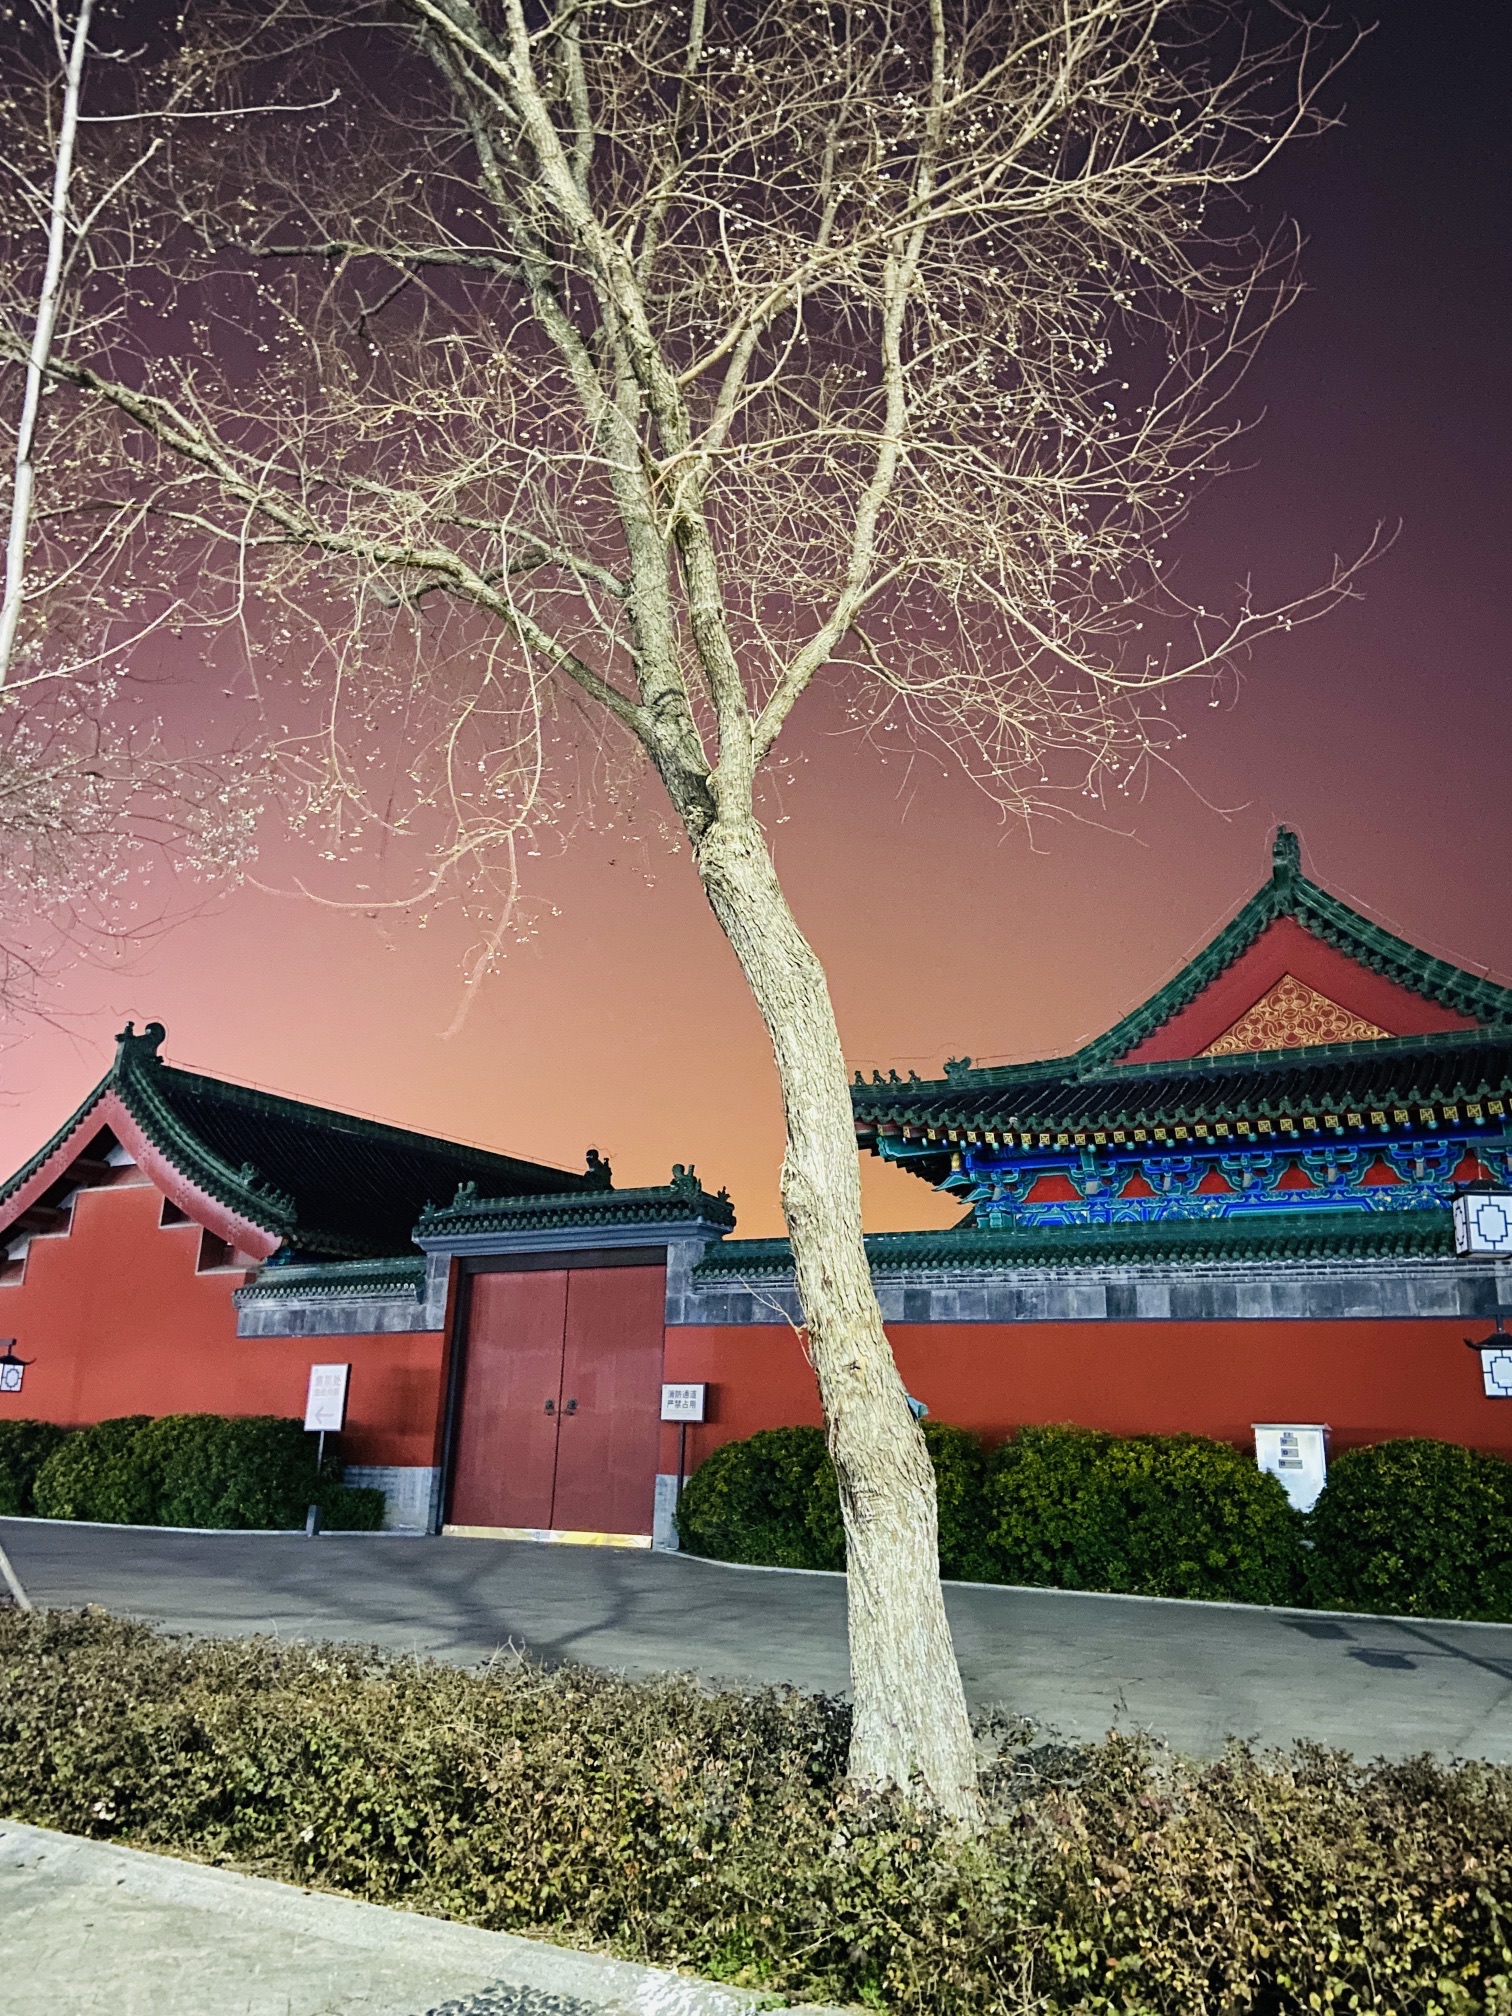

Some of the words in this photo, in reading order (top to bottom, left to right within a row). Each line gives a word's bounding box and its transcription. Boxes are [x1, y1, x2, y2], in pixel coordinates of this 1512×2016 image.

[667, 1390, 697, 1399] 消防通道
[667, 1400, 697, 1409] 严禁占用
